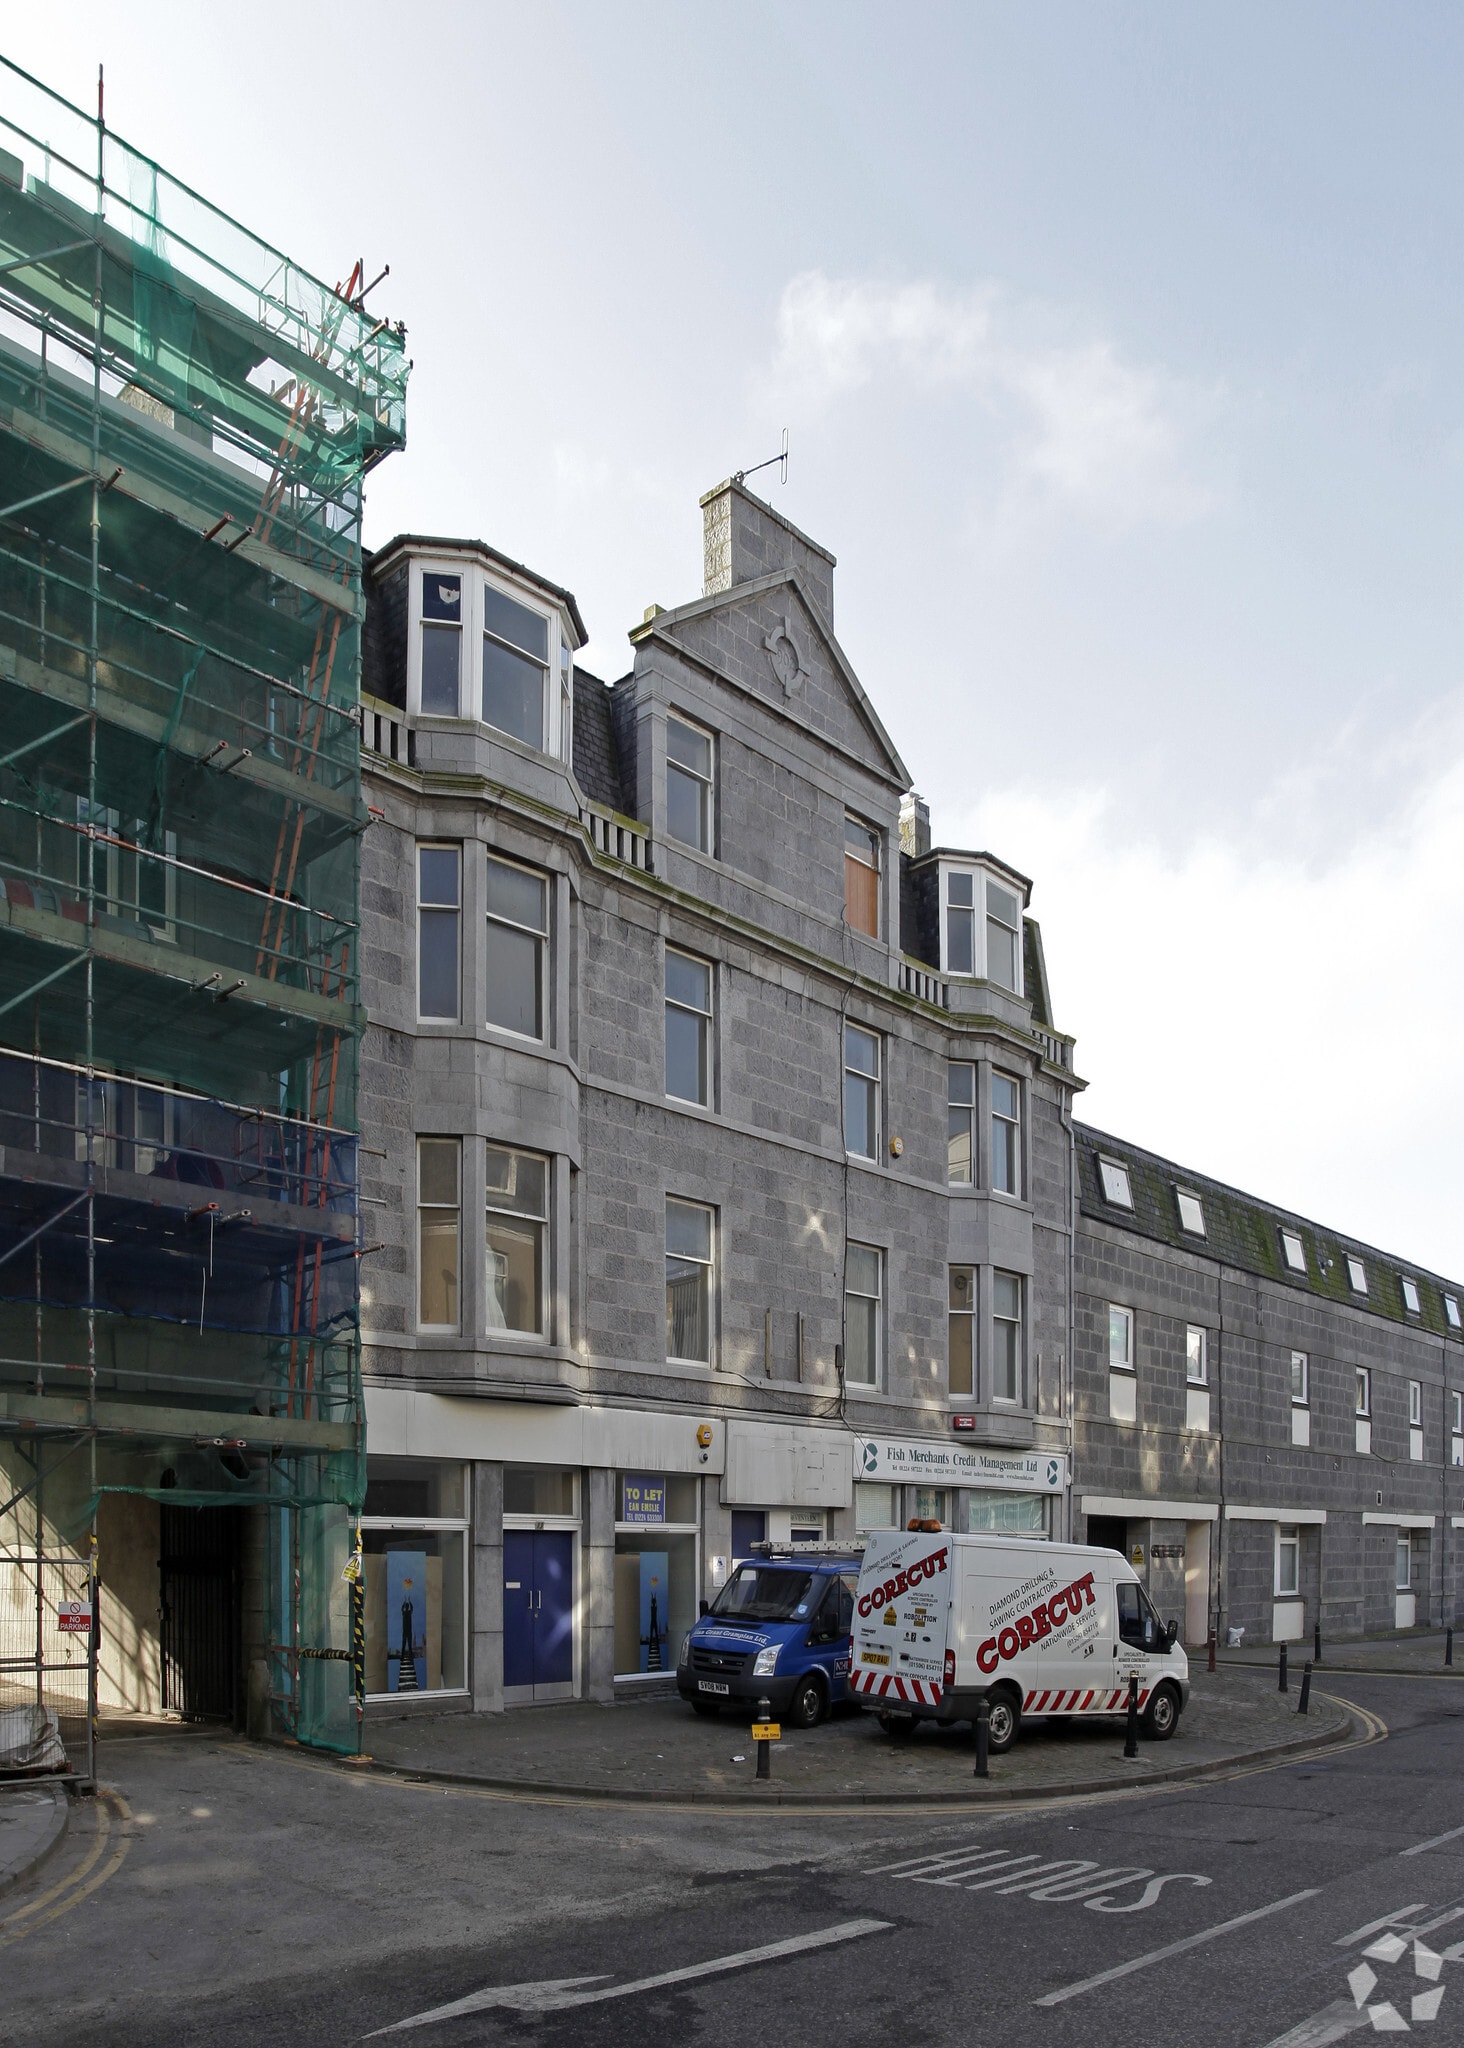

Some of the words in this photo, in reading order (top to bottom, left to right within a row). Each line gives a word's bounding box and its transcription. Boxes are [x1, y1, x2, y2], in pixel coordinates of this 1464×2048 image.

[887, 1447, 905, 1461] Fish
[909, 1449, 949, 1464] Merchants
[953, 1453, 976, 1466] Credit
[979, 1456, 1023, 1472] Management
[1026, 1460, 1038, 1472] Ltd
[626, 1488, 640, 1500] TO
[644, 1489, 662, 1501] LET
[857, 1546, 948, 1618] CORECUT
[989, 1589, 1020, 1615] DIAMOND
[1021, 1571, 1049, 1594] DRILLING
[1049, 1567, 1055, 1576] &
[903, 1612, 938, 1623] ROBOLITION
[976, 1571, 1096, 1674] CORECUT
[989, 1608, 1015, 1631] SAWING
[1016, 1579, 1058, 1613] CONTRACTORS
[723, 1630, 753, 1640] Grampian
[1040, 1624, 1076, 1651] NATIONWIDE
[1076, 1607, 1097, 1628] SERVICE
[863, 1653, 876, 1663] SP07
[860, 1845, 1213, 1913] SOUTH
